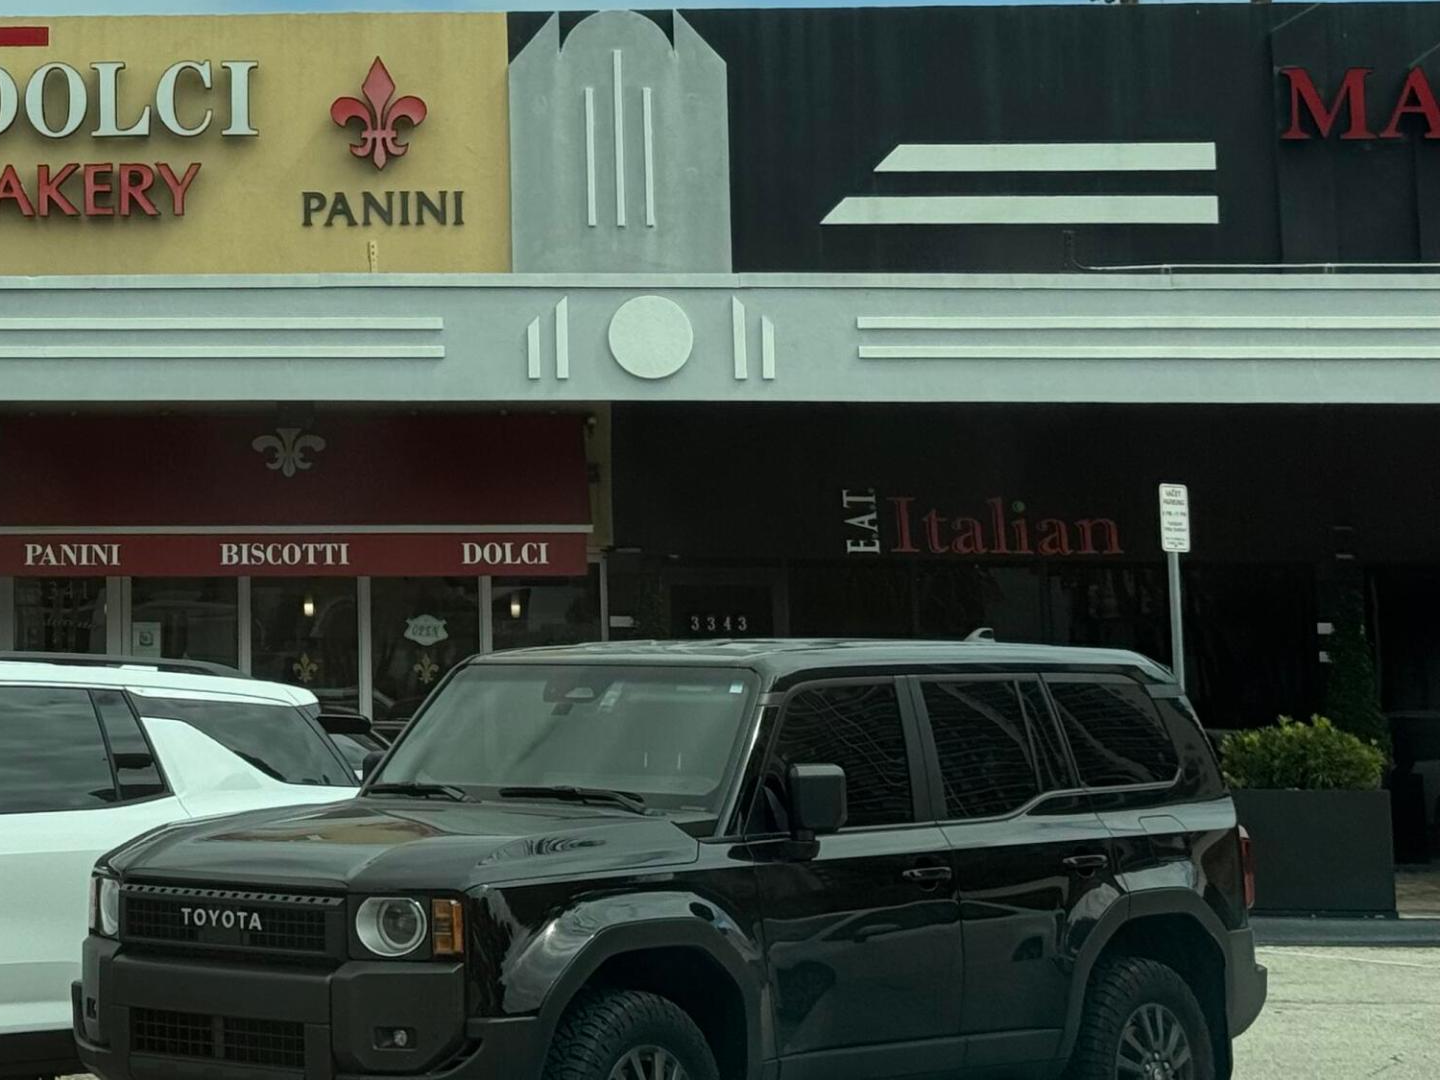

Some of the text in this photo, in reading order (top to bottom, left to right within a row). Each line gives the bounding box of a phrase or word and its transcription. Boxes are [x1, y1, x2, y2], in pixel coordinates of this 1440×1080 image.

[1280, 65, 1440, 140] MA
[302, 190, 465, 227] PANINI
[886, 496, 1124, 554] Italian
[24, 543, 121, 567] PANINI
[220, 542, 350, 566] BISCOTTI
[461, 541, 550, 565] DOLCI
[691, 616, 748, 631] 3343
[181, 907, 263, 932] TOYOTA
